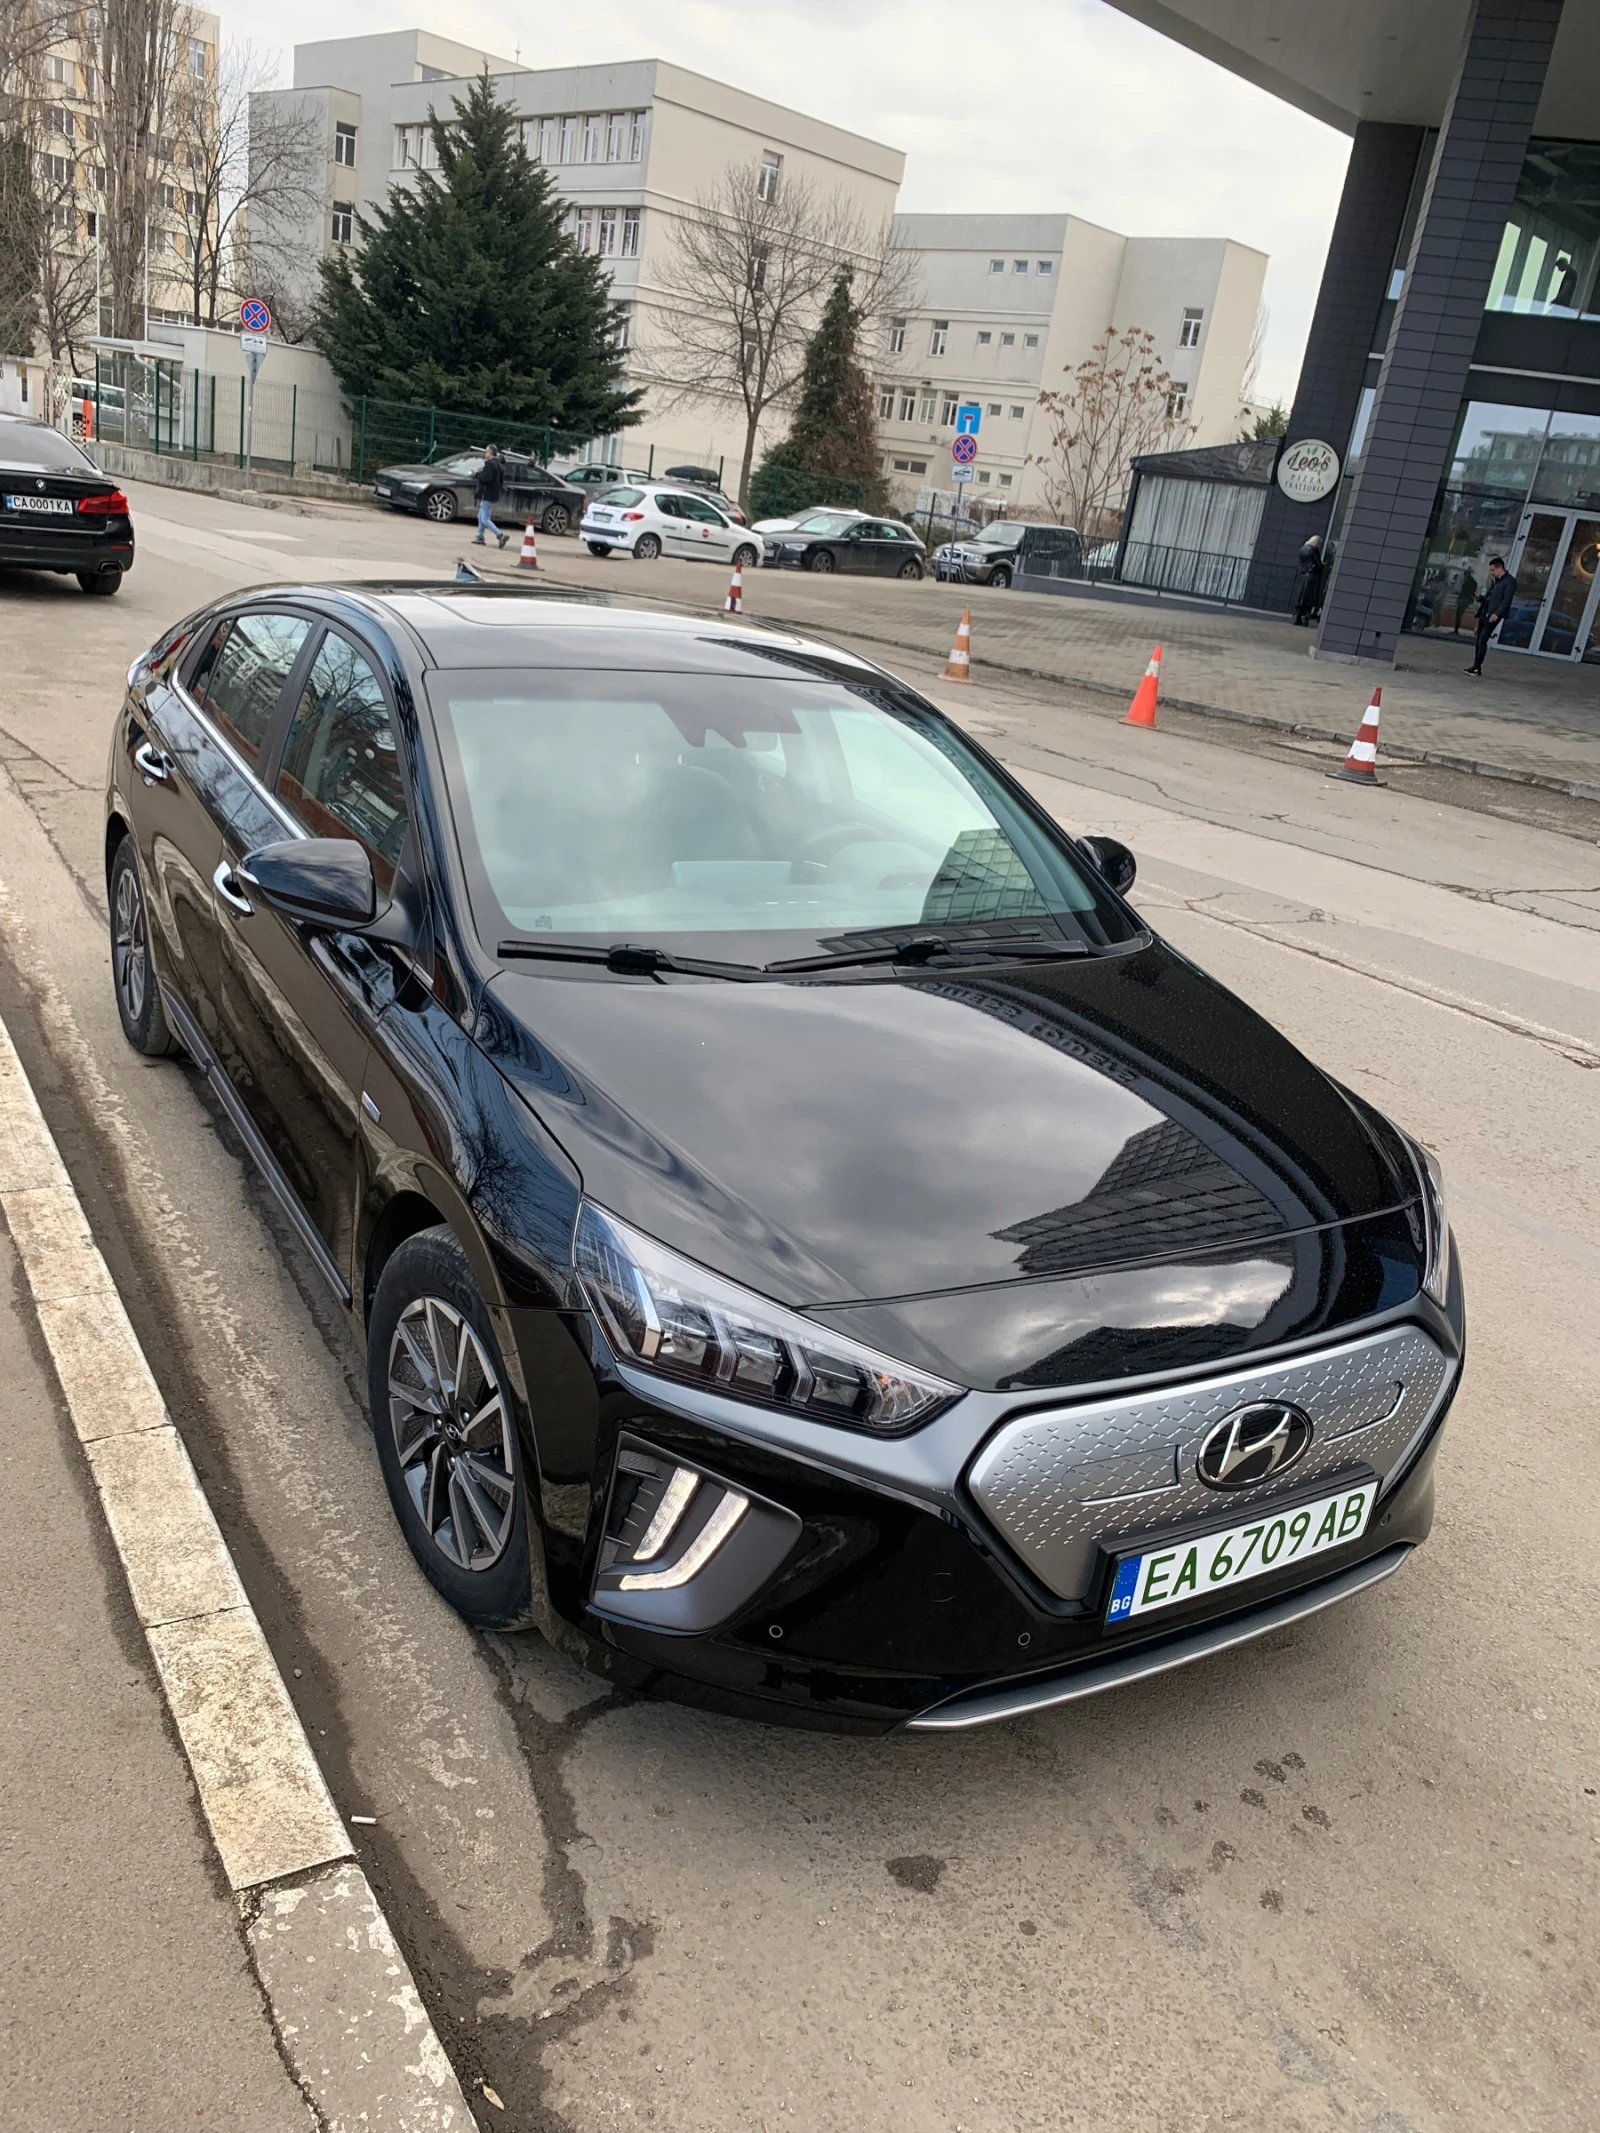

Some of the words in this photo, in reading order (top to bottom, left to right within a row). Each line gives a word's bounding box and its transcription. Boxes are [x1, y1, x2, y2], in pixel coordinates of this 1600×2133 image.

[1287, 450, 1331, 472] Leo's
[1285, 481, 1325, 493] TRATTORIA
[1290, 474, 1321, 485] PIZZA
[13, 496, 28, 508] CA
[29, 498, 54, 510] 0001
[57, 500, 71, 512] KA
[1141, 1552, 1198, 1606] EA
[1209, 1511, 1311, 1582] 6709
[1312, 1492, 1366, 1548] AB
[1110, 1595, 1132, 1614] BG
